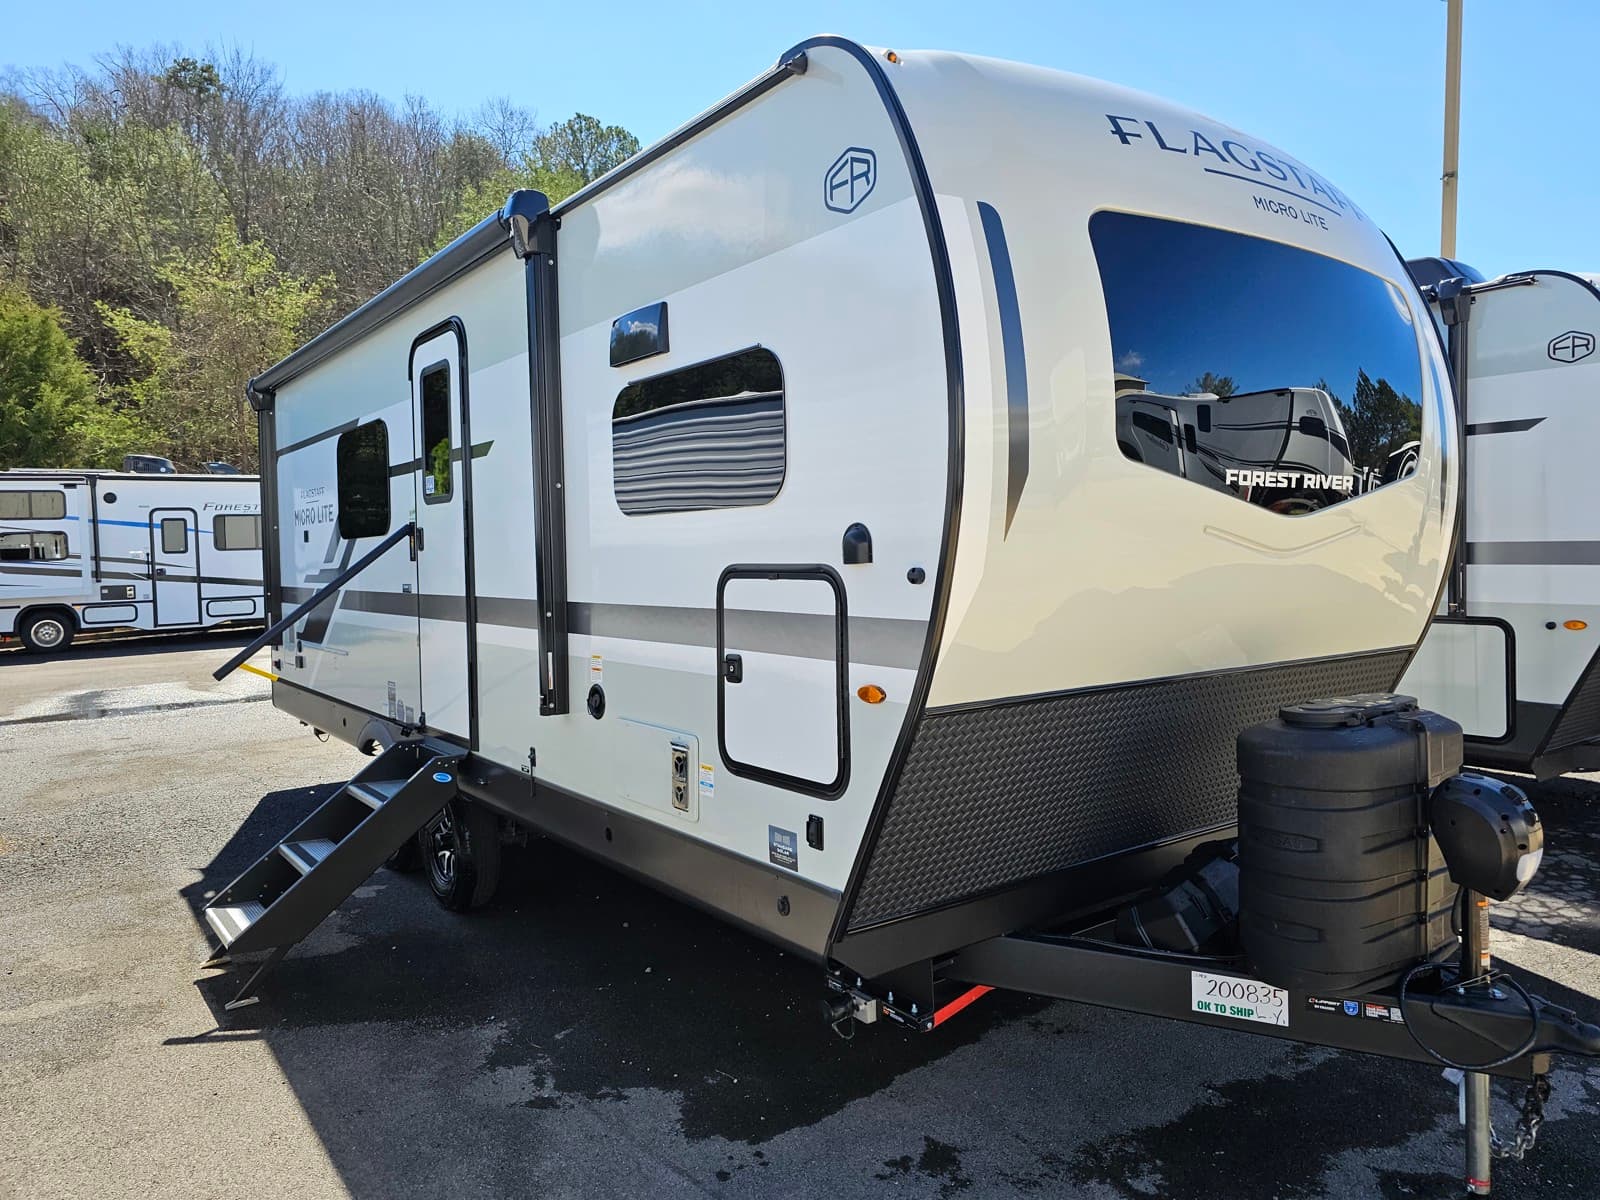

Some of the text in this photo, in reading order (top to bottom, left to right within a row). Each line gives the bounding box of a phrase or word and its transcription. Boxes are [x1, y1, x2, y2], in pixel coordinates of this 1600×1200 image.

[1252, 195, 1329, 231] MICRO LITE
[1225, 468, 1354, 491] FOREST RIVER
[294, 504, 334, 527] MICRO LITE
[1205, 979, 1284, 1008] 200835
[1197, 1000, 1255, 1018] OK TO SHIP
